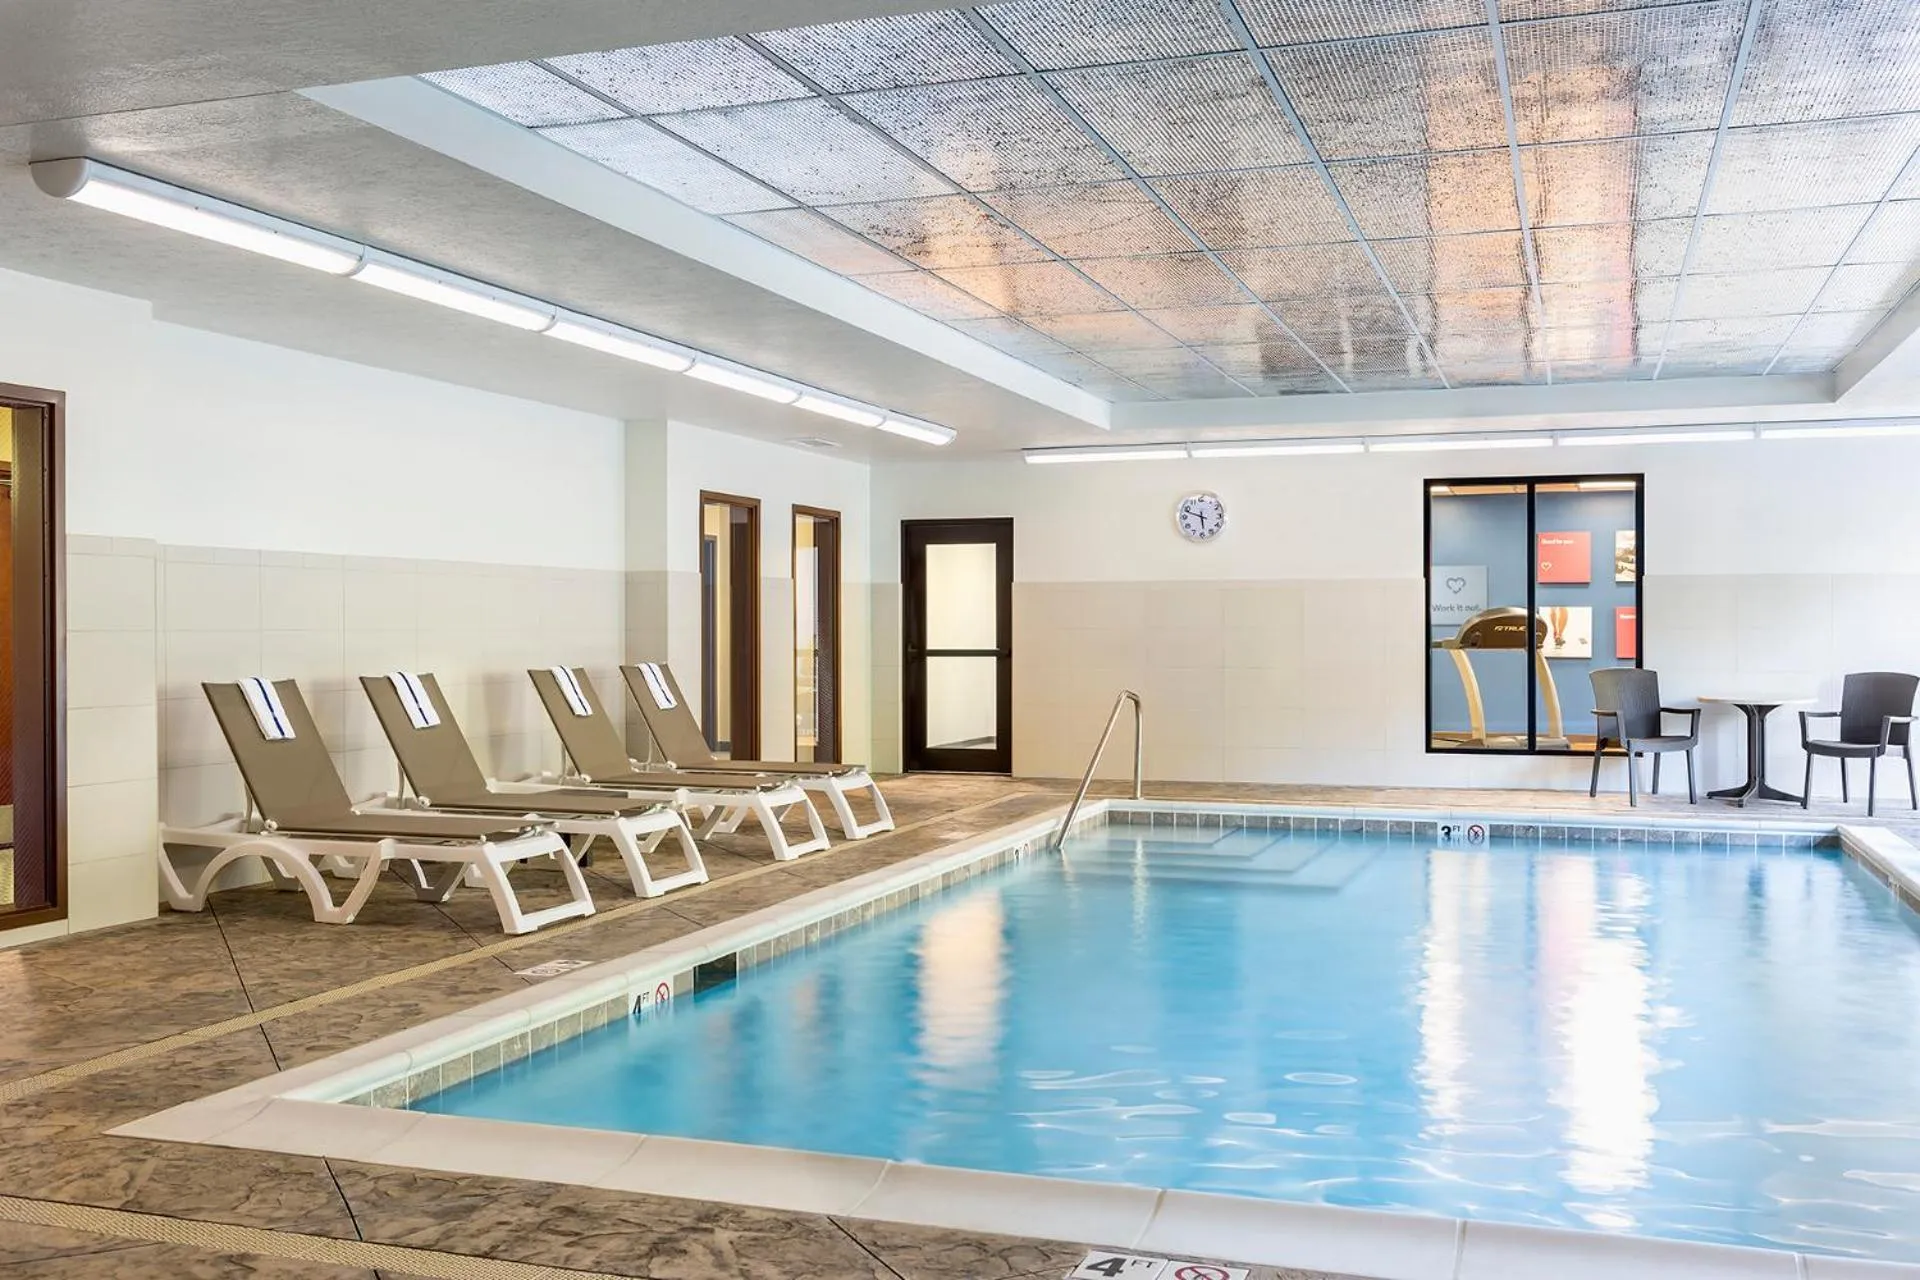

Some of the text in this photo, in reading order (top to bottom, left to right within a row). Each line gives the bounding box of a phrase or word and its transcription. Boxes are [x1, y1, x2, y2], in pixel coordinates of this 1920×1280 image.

[1432, 603, 1456, 613] Work
[1085, 1257, 1158, 1278] 4 FT
